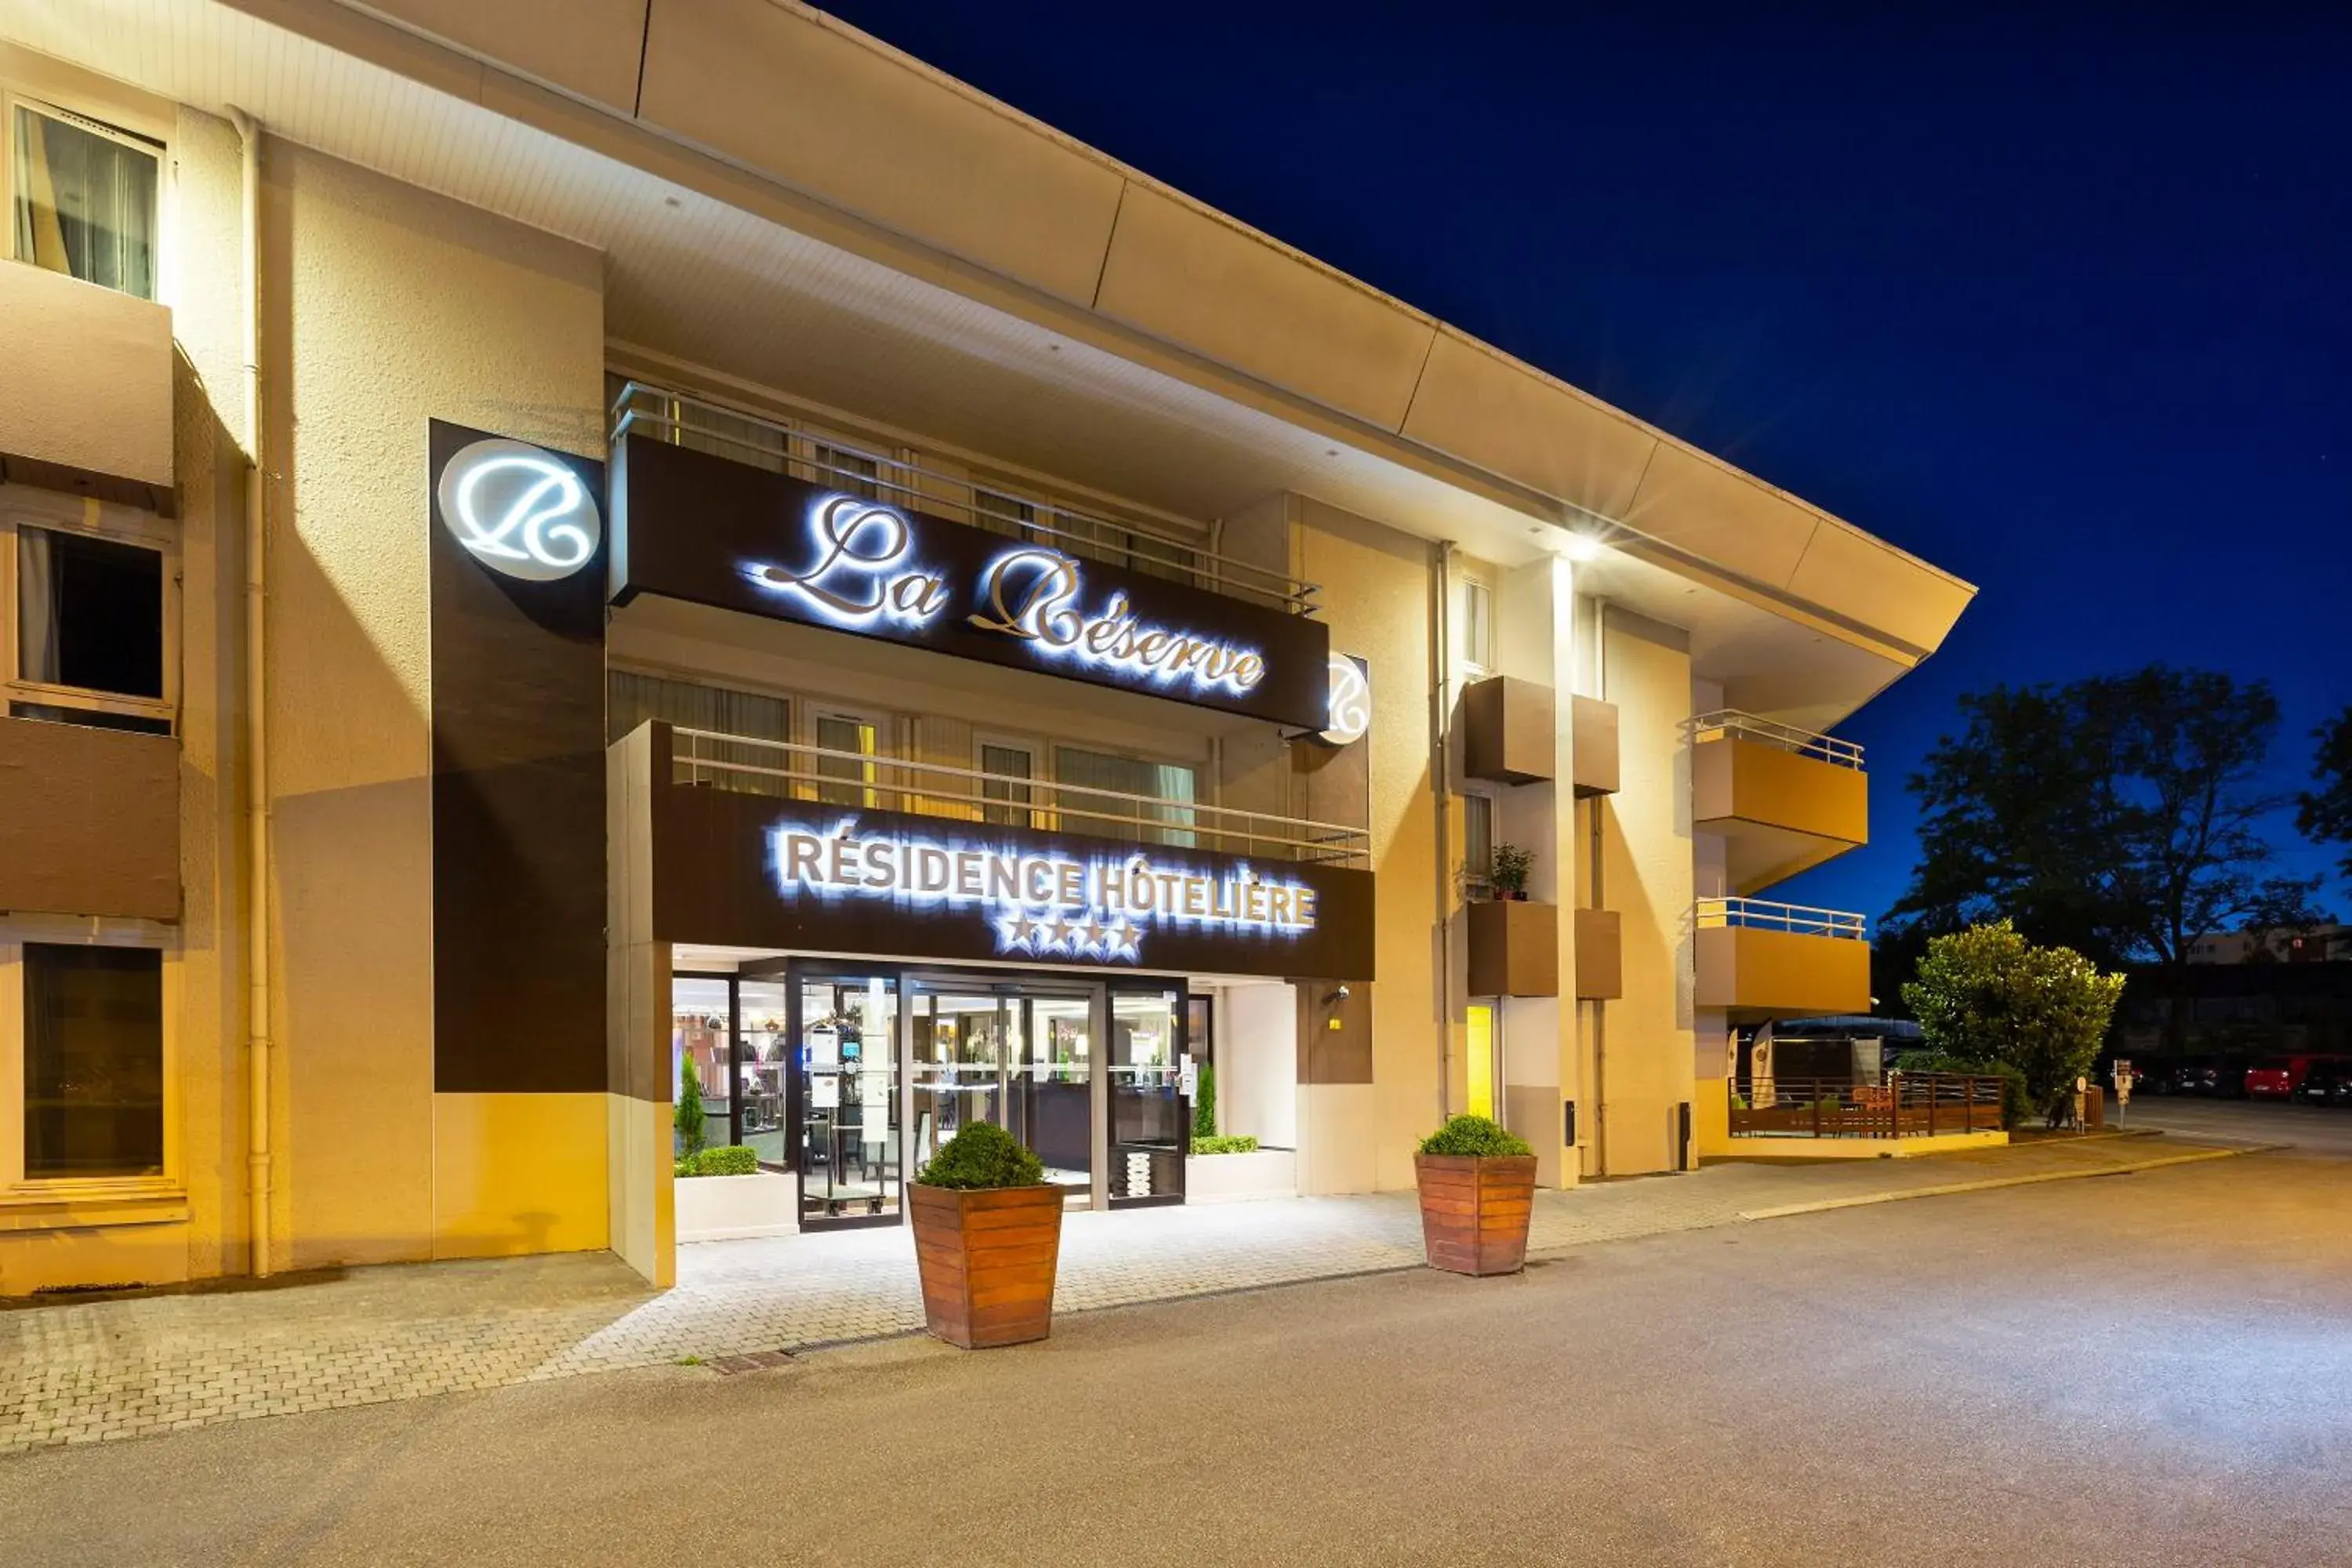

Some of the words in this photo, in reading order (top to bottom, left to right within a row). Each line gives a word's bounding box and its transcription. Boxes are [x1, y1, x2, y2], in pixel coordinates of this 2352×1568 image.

[762, 497, 949, 615] La
[967, 550, 1265, 687] Réserve
[786, 825, 1085, 904] RÉSIDENCE
[1099, 859, 1316, 925] HÔTELIÈRE
